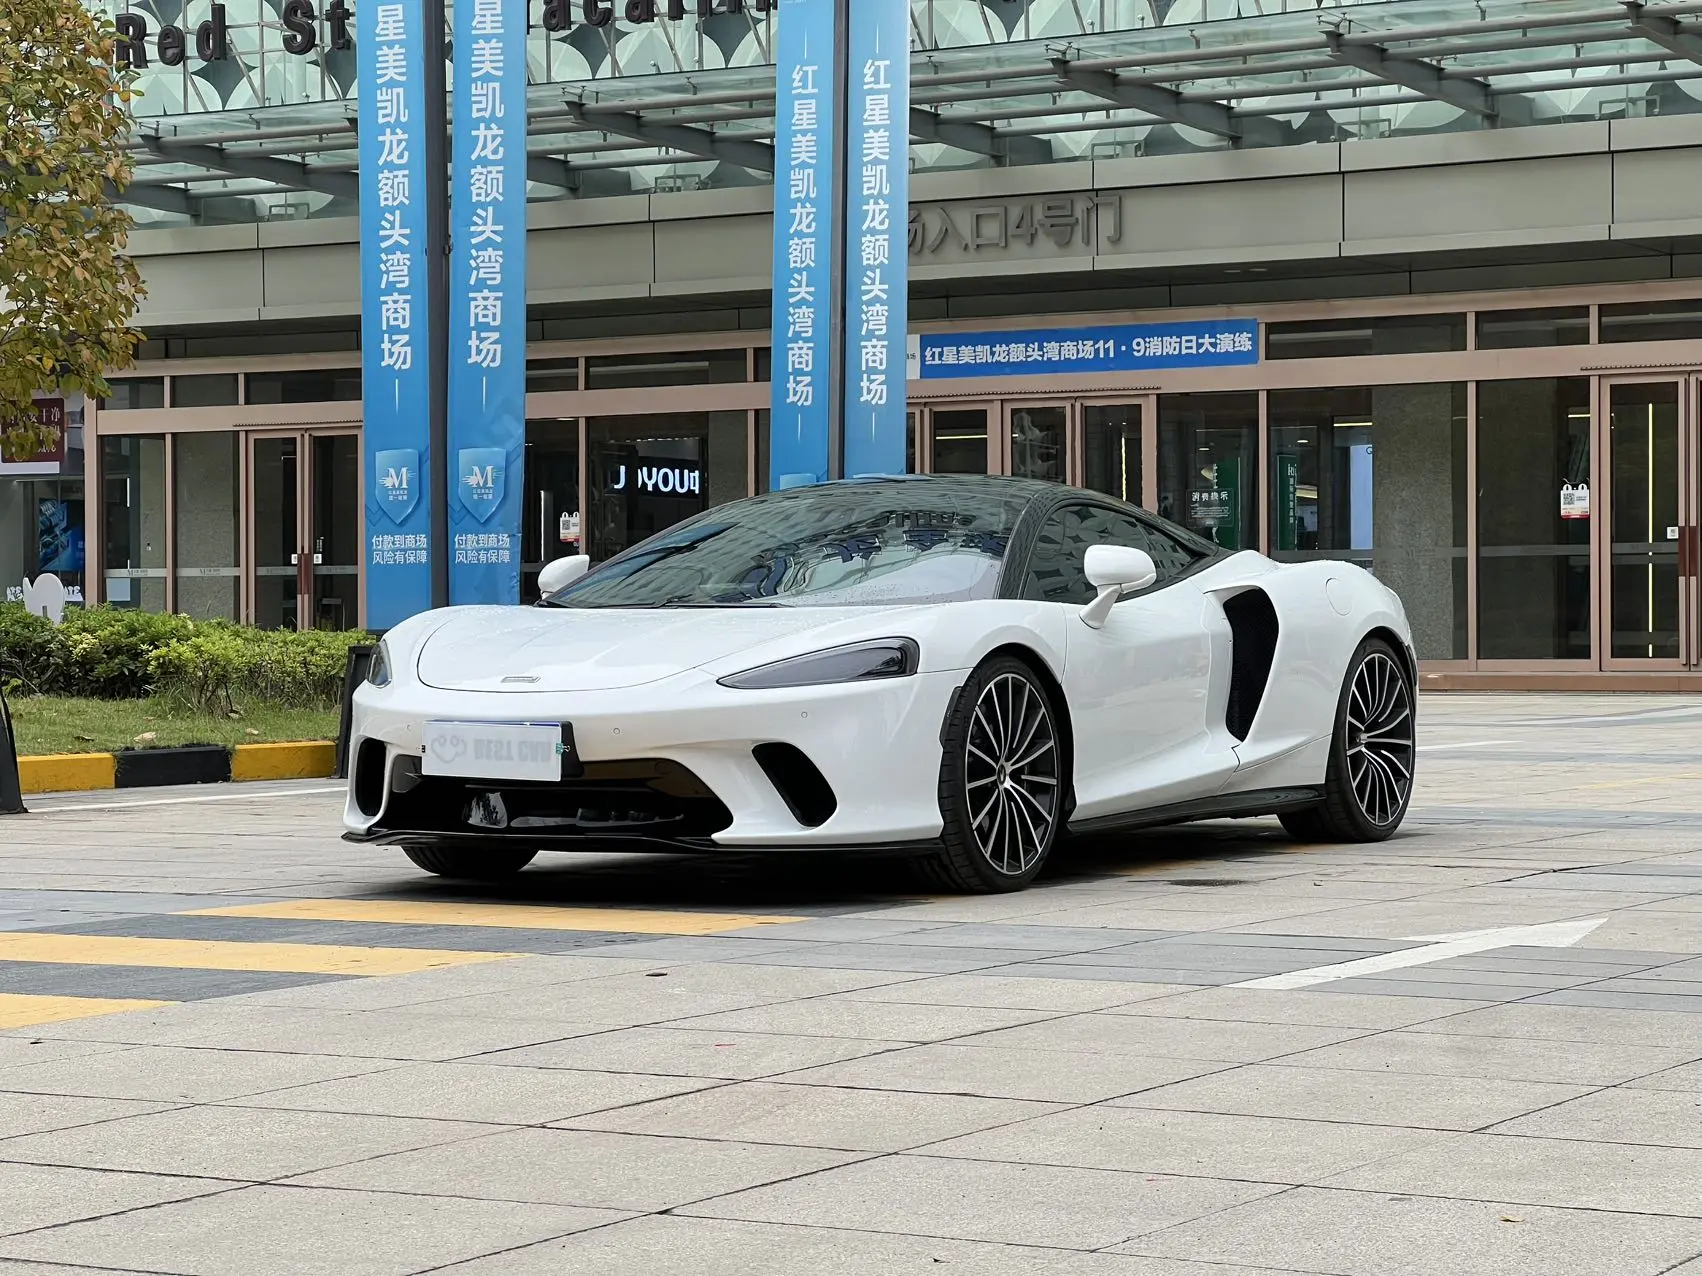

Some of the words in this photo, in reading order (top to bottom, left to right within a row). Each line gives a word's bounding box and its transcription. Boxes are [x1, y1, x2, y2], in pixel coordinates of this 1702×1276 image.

[115, 4, 228, 69] Red
[786, 65, 819, 406] 红星美凯龙额头湾商场
[860, 59, 892, 405] 红星美凯龙额头湾商场
[372, 534, 427, 549] 付款到商场
[455, 533, 510, 548] 付款到商场
[372, 550, 428, 564] 风险有保障
[455, 550, 511, 564] 风险有保障
